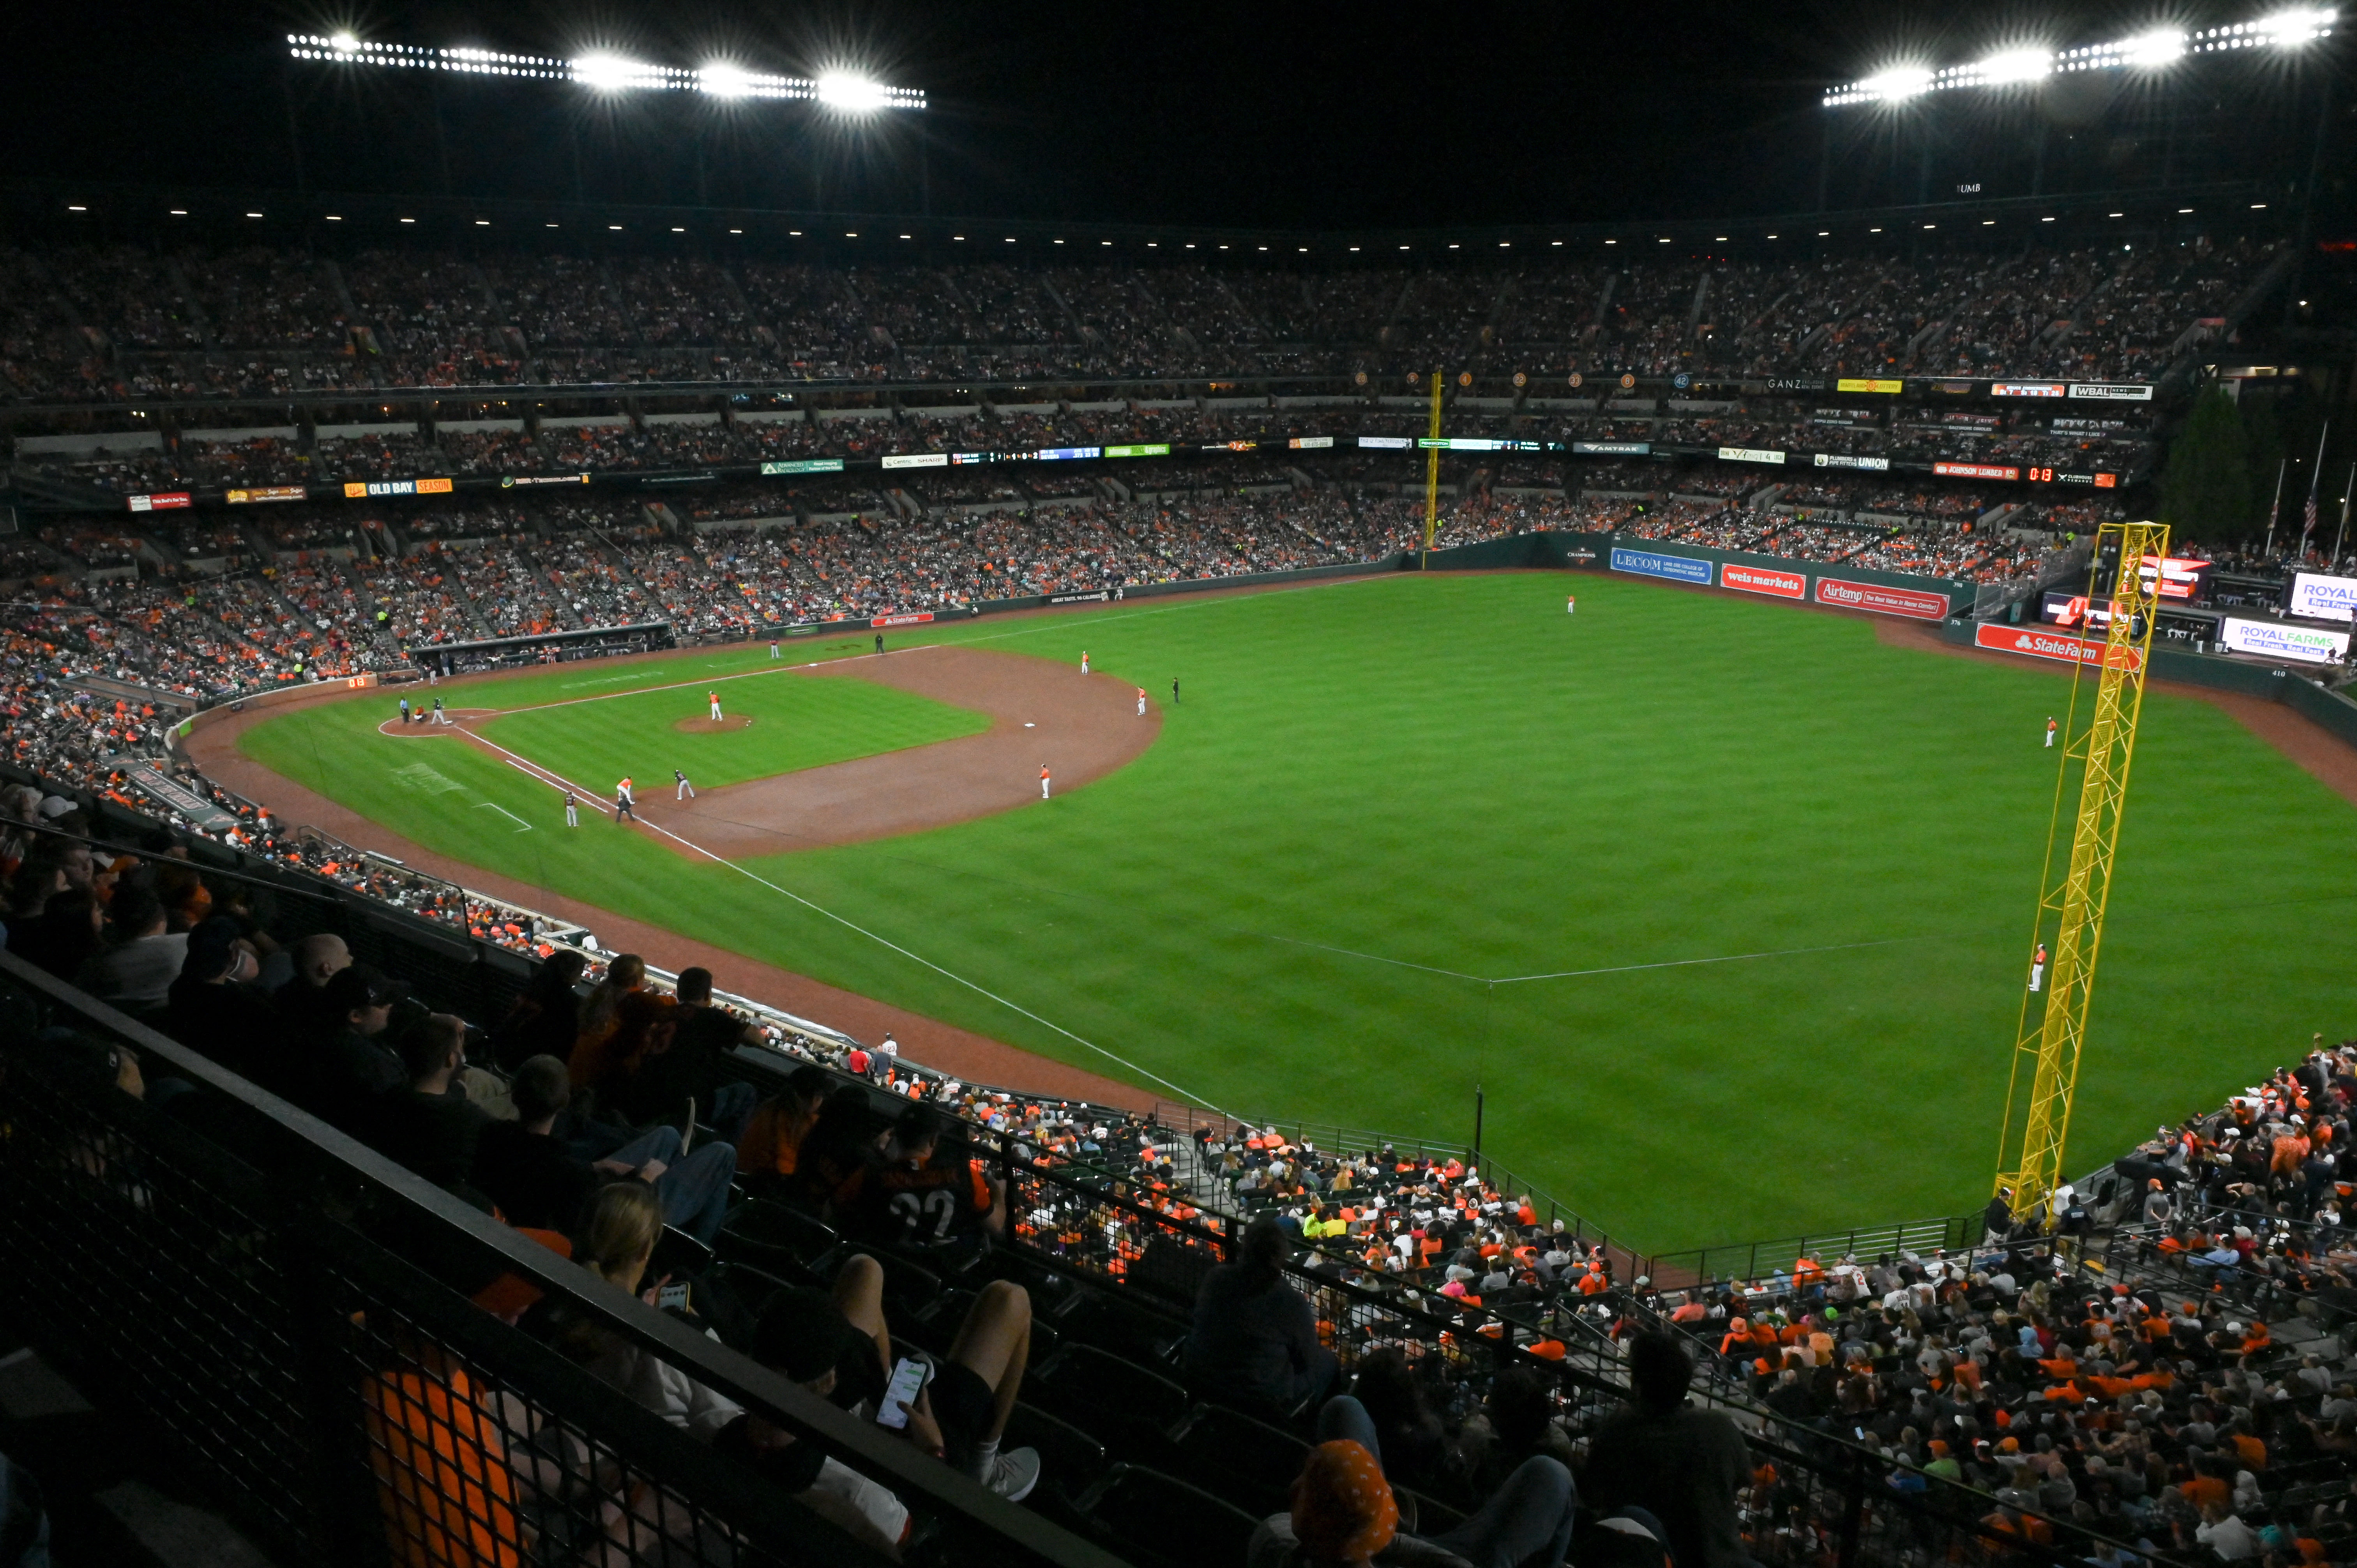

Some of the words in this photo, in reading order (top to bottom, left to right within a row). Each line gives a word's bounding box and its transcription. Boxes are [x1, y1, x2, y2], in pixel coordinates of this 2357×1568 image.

[1768, 379, 1800, 388] GANZ
[2078, 387, 2110, 396] WBAL
[1859, 457, 1888, 468] UNION
[1949, 466, 1977, 474] JOHNSON
[2030, 468, 2052, 482] 0:13
[369, 483, 390, 494] OLD
[392, 482, 413, 493] BAY
[419, 480, 449, 491] SEASON
[1728, 572, 1751, 583] weis
[1753, 575, 1799, 590] markets
[1823, 584, 1862, 600] Airtemp
[2304, 584, 2357, 600] ROYAL
[1918, 602, 1936, 610] Comfort
[2311, 599, 2329, 607] Real
[1857, 1273, 1864, 1285] 2
